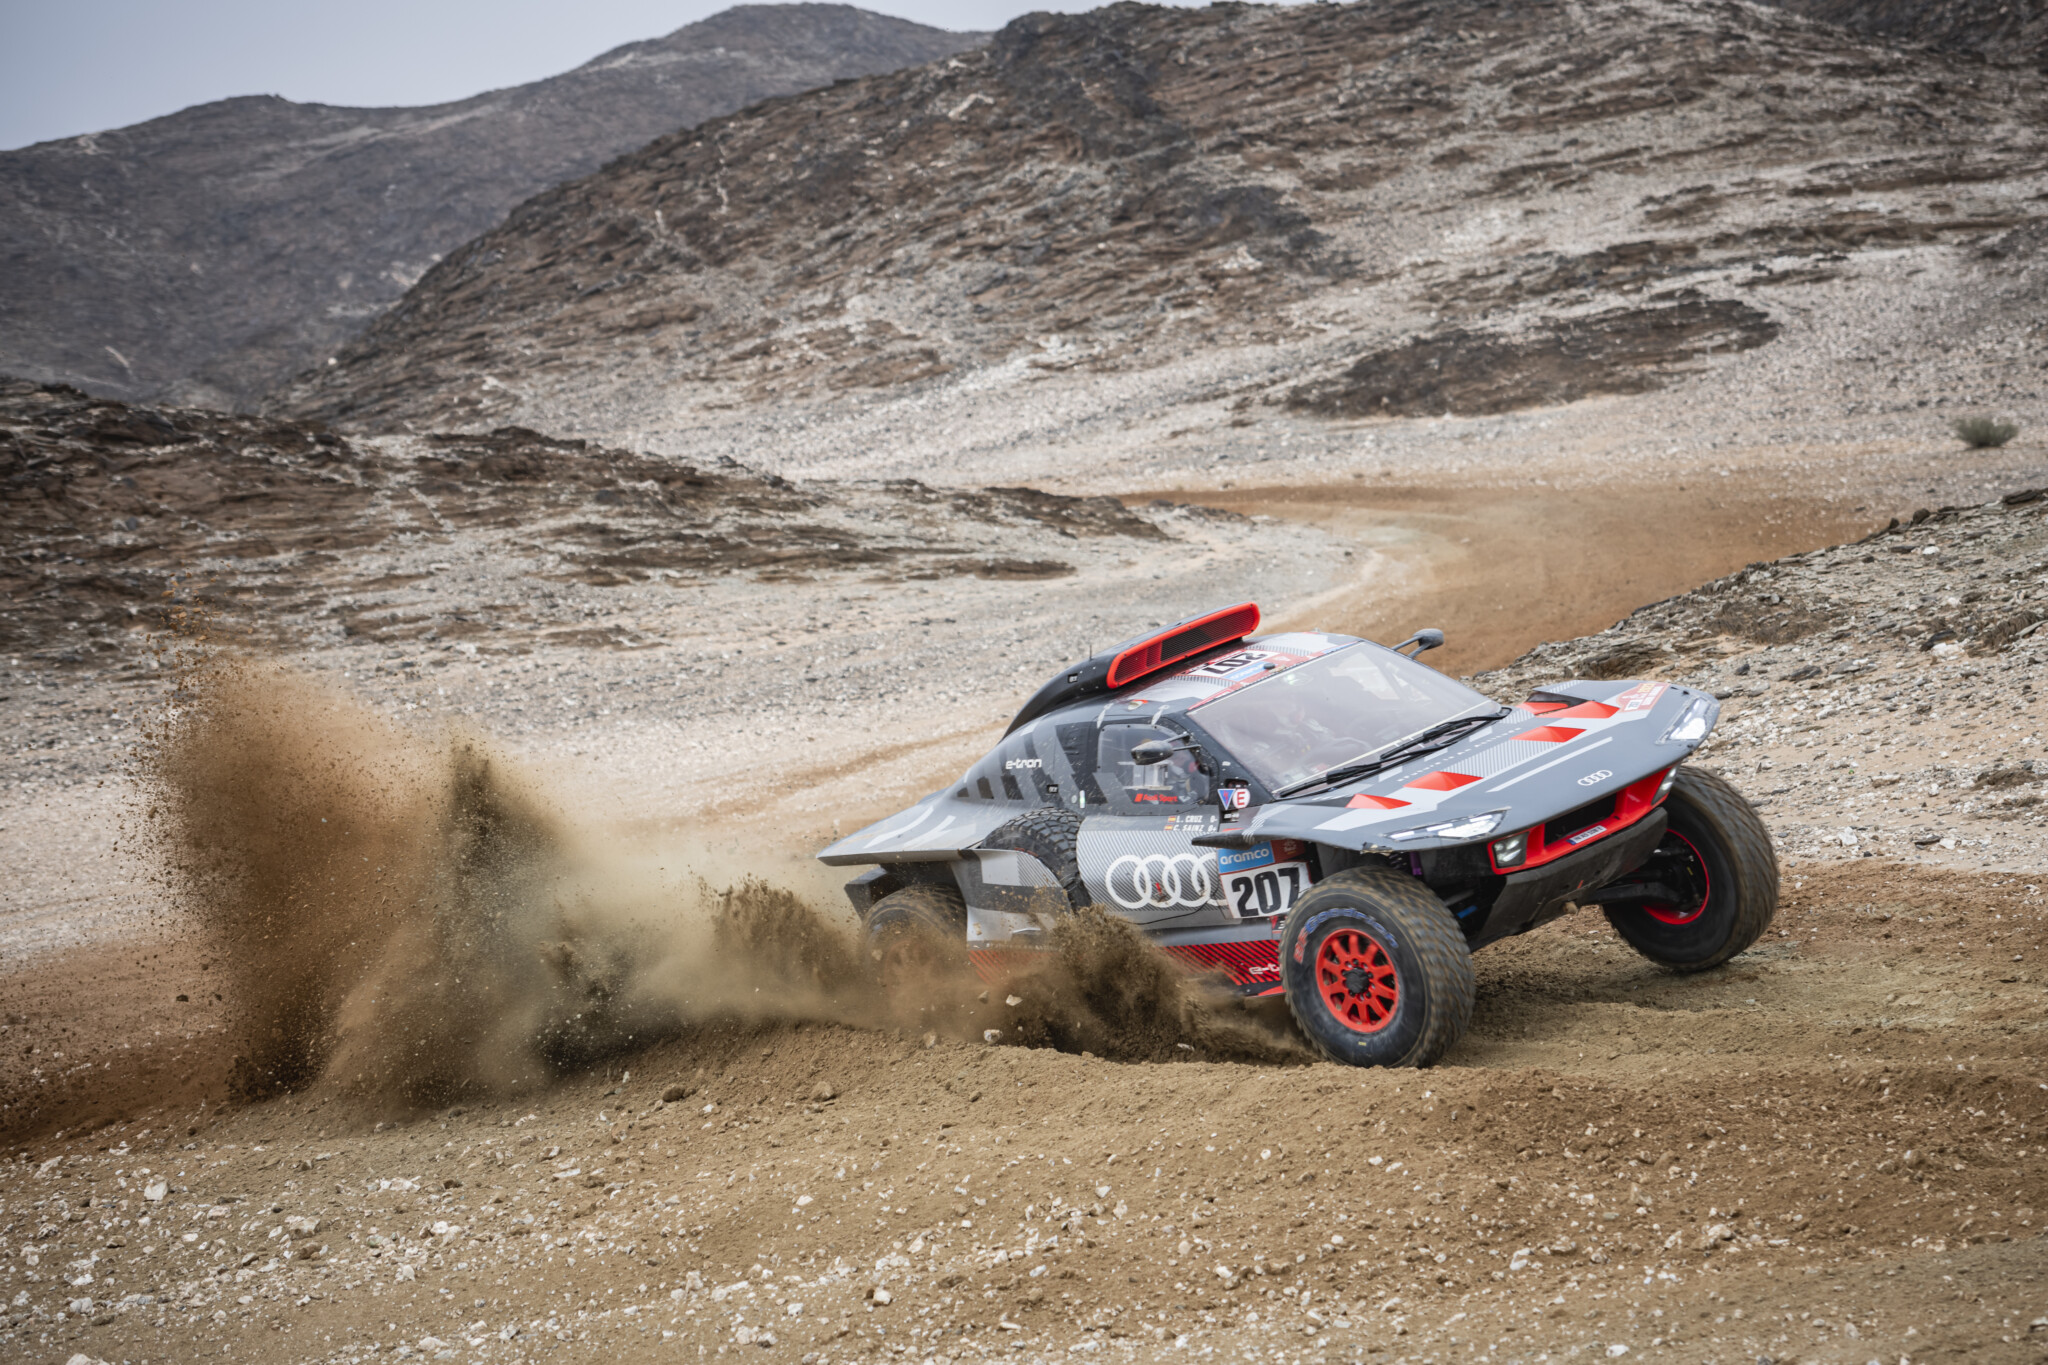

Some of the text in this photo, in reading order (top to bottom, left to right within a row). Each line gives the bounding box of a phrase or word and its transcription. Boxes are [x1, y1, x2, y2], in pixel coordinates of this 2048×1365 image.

[1202, 652, 1268, 675] 207
[1005, 758, 1042, 770] e-tron
[1159, 794, 1178, 803] Sport
[1237, 791, 1246, 806] E
[1176, 815, 1184, 823] L.
[1185, 815, 1203, 823] CRUZ
[1182, 824, 1205, 832] SAINZ
[1220, 848, 1270, 865] aramco
[1231, 867, 1300, 917] 207
